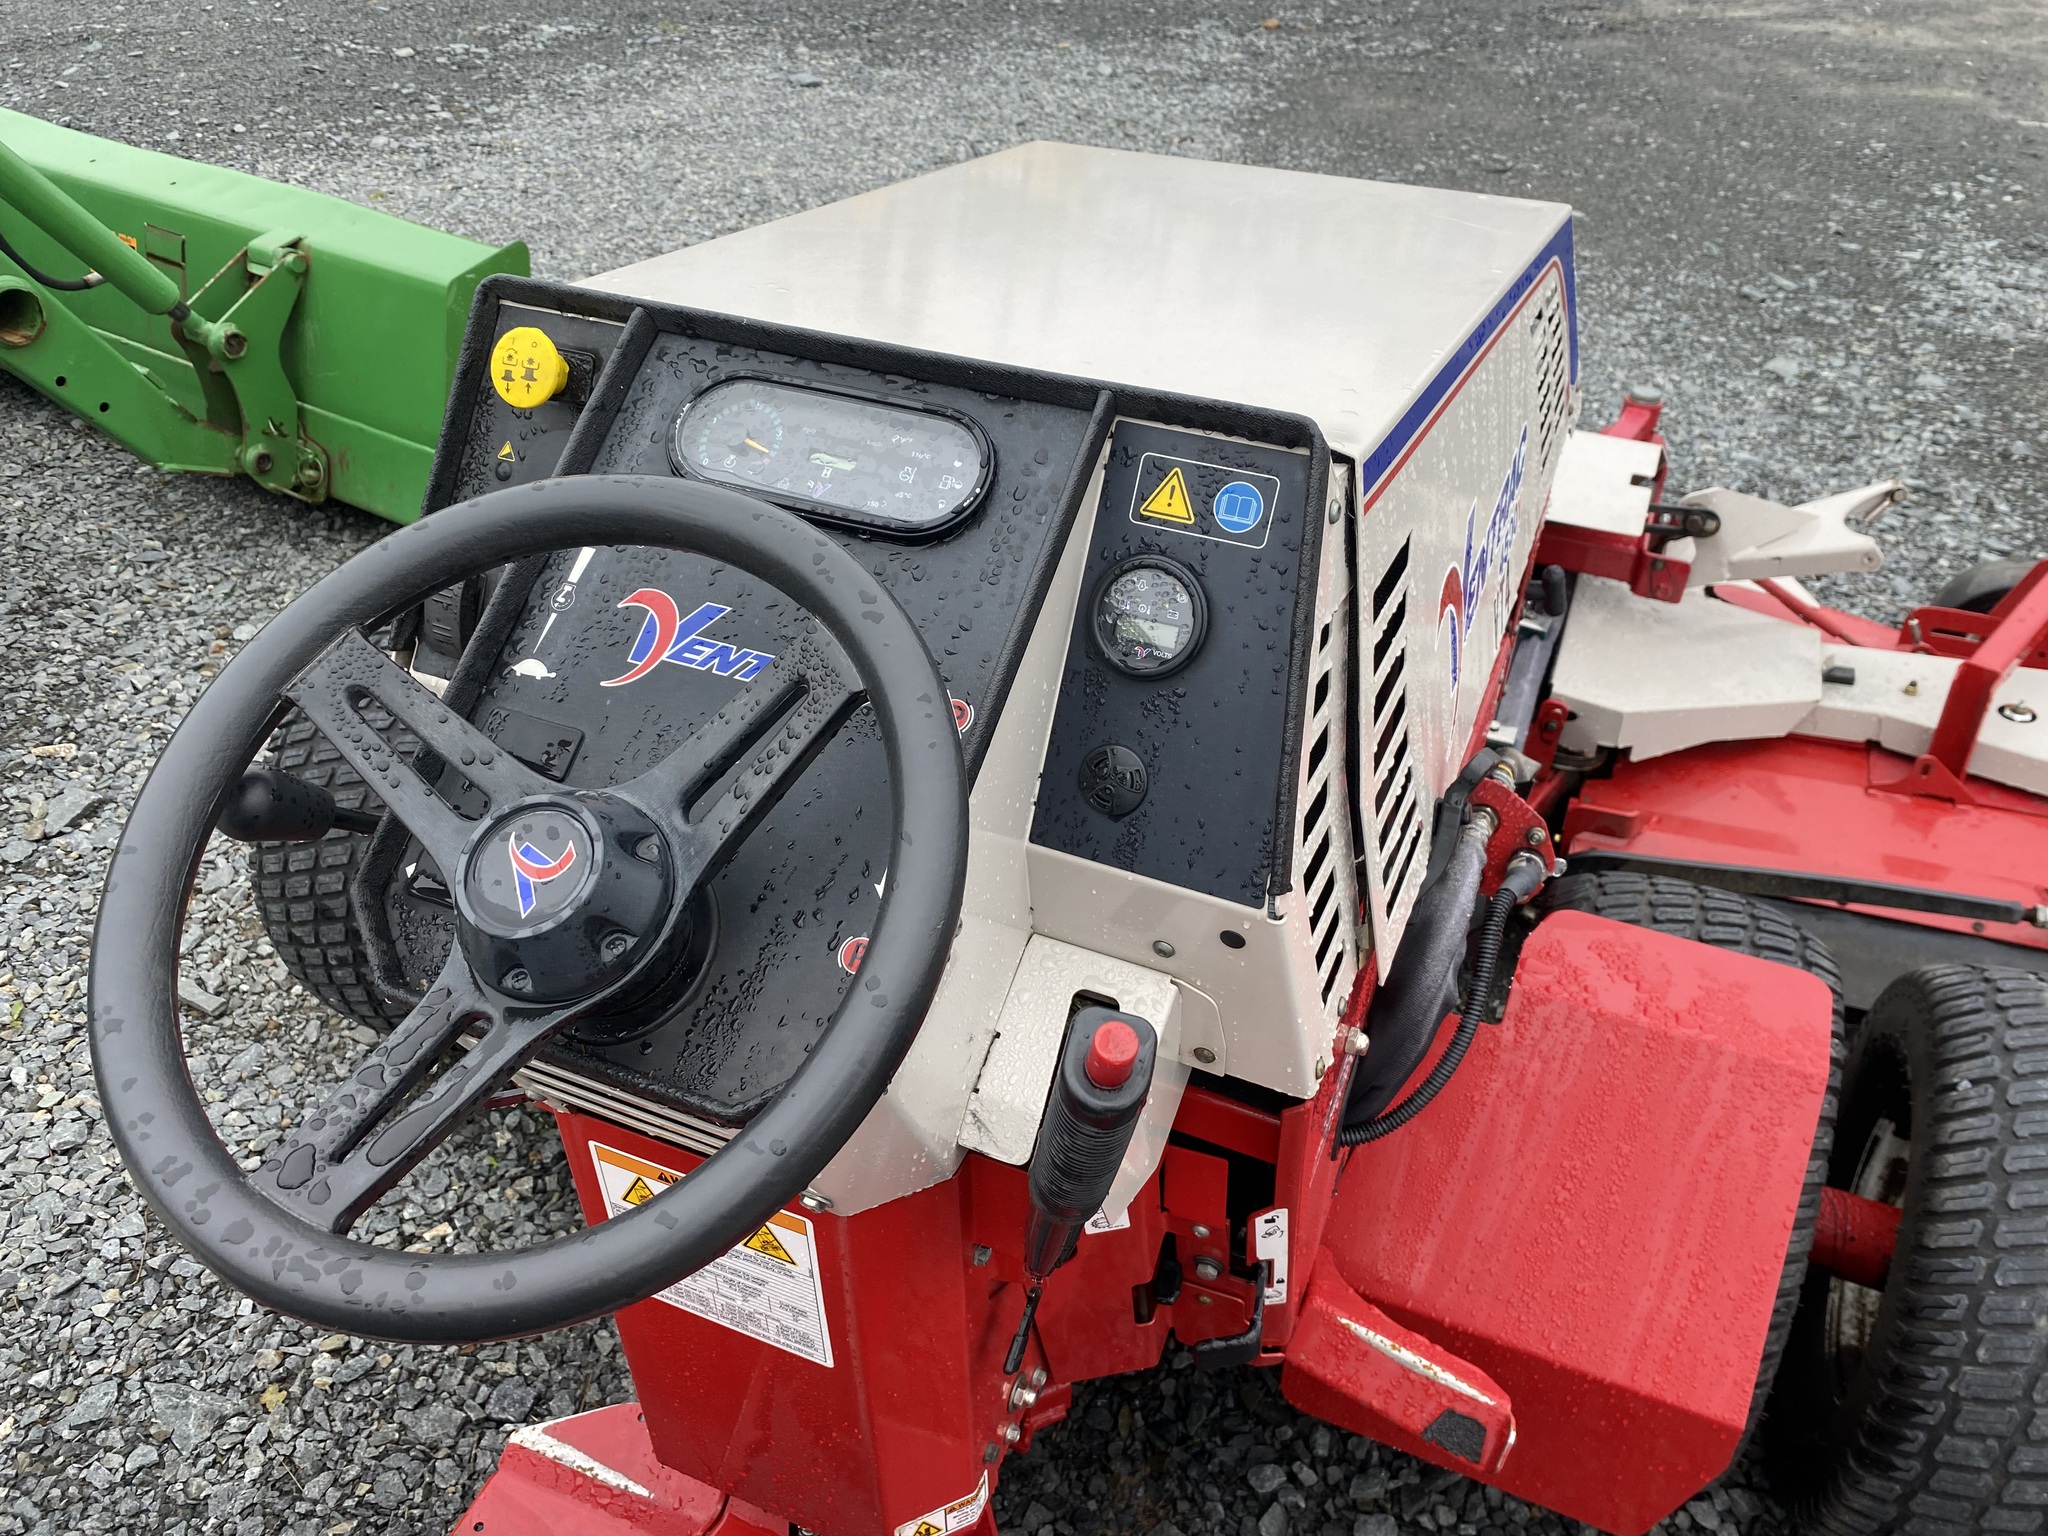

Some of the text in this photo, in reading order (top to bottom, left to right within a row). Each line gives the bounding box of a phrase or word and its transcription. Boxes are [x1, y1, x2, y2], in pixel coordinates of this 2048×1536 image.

[776, 429, 783, 437] 3
[702, 457, 709, 466] 0
[1436, 421, 1528, 700] VENTRAC
[600, 588, 776, 687] VENT
[1153, 649, 1173, 659] VOLTS
